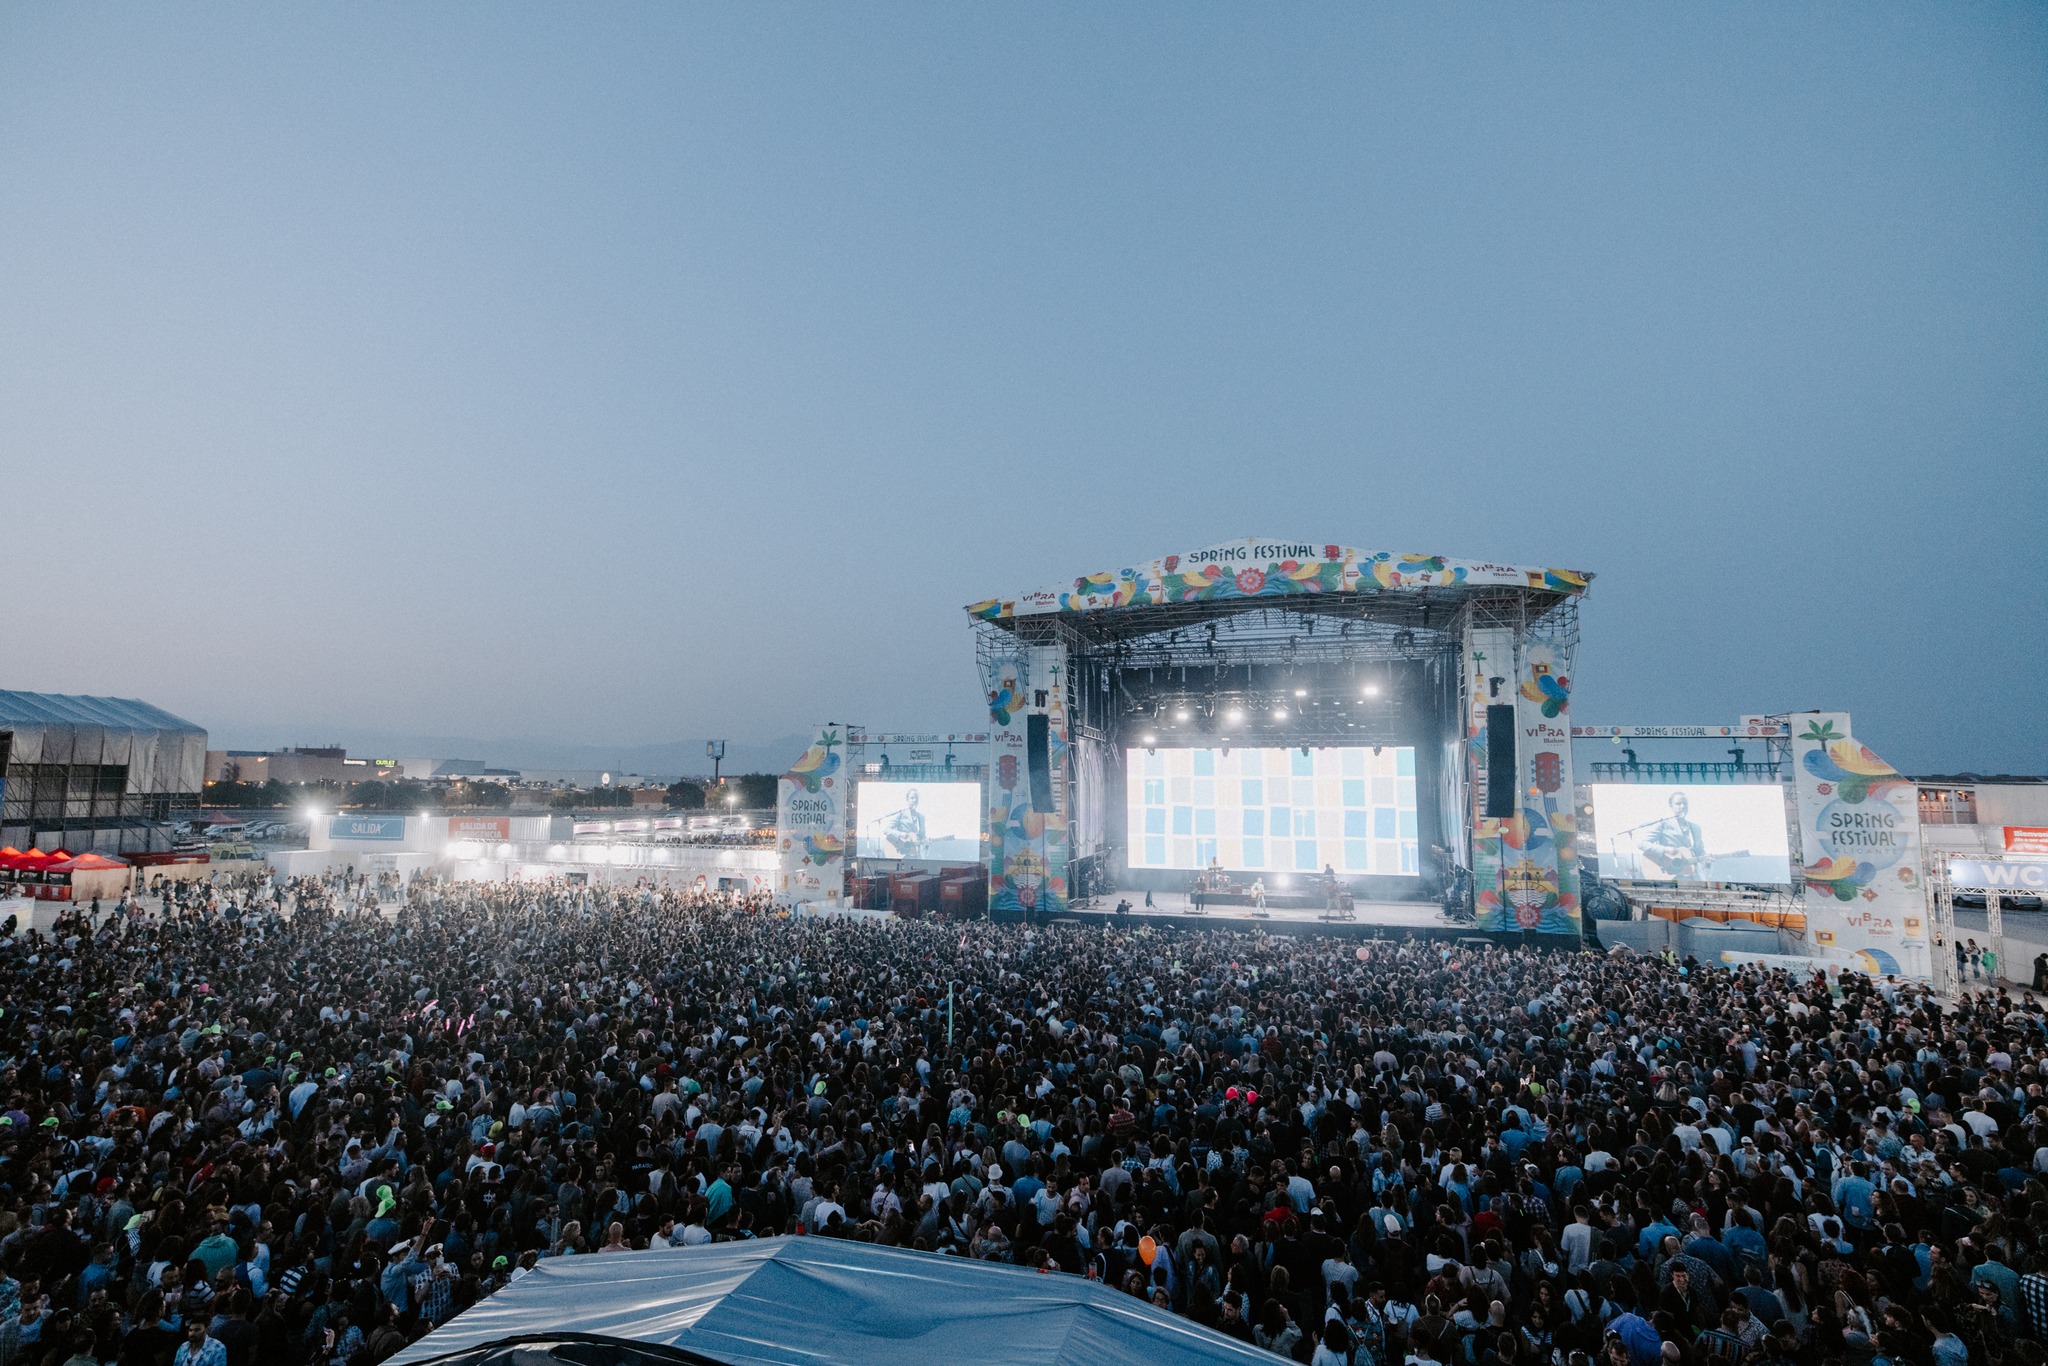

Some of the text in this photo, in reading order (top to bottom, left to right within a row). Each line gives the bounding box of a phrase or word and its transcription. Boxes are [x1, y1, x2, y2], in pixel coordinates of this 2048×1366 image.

[1471, 564, 1516, 573] VIBRA
[1023, 592, 1055, 601] VIBRA
[995, 730, 1022, 742] VIBRA
[1526, 724, 1565, 737] VIBRA
[351, 823, 381, 833] SALIDA
[460, 822, 497, 830] SALIDA DE
[1981, 864, 2044, 886] WC
[1847, 913, 1893, 928] VIBRA
